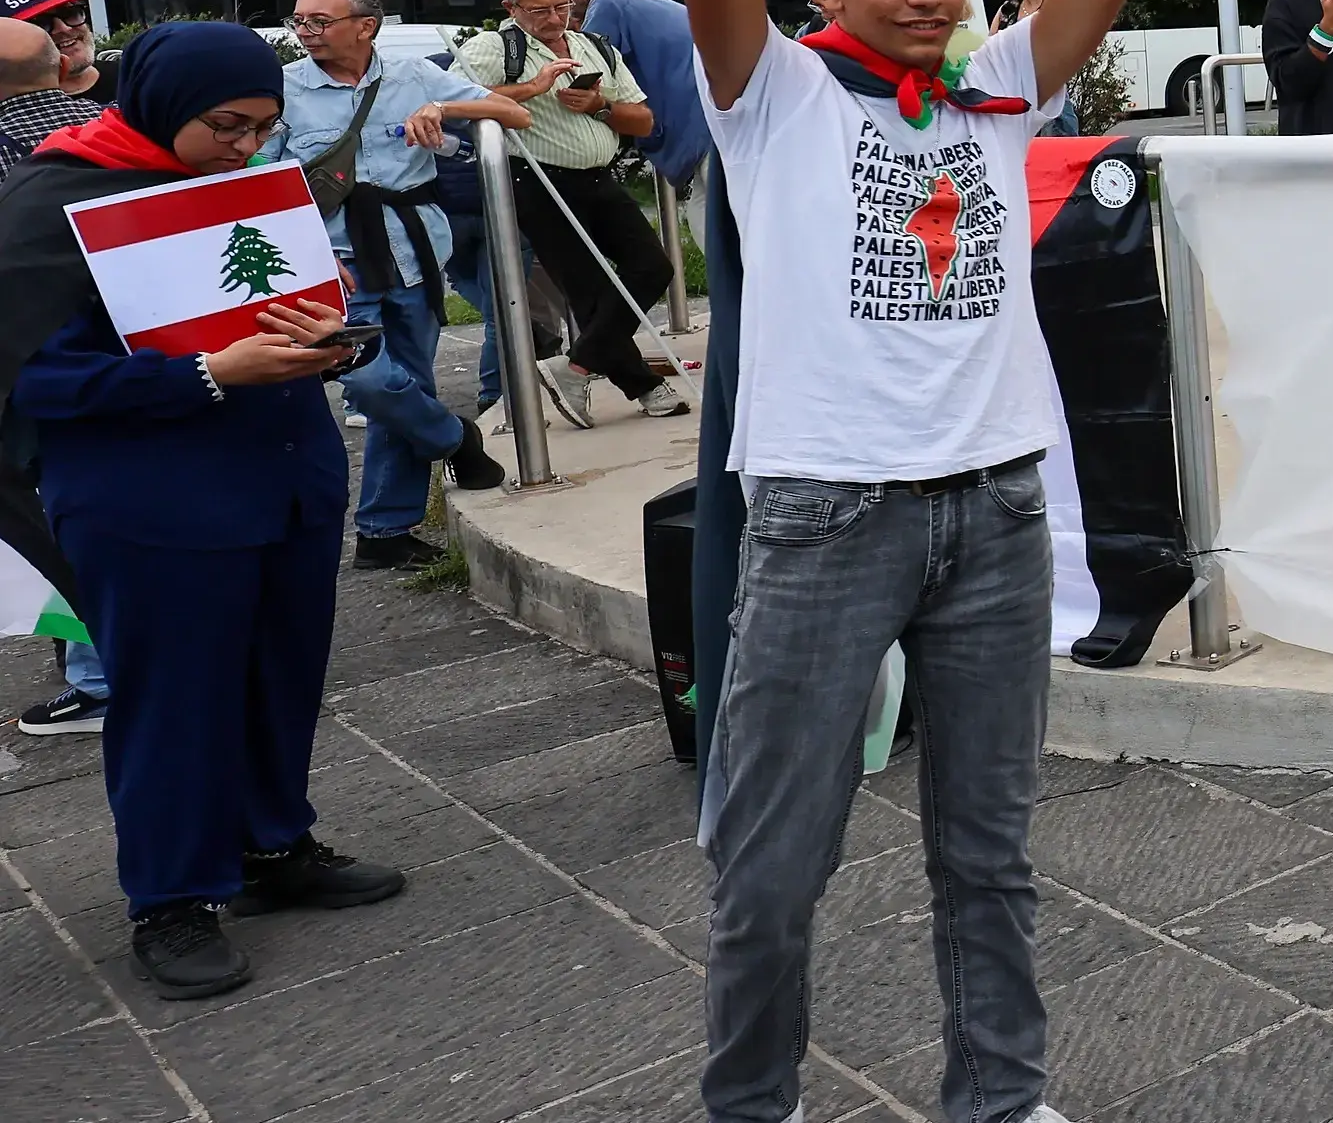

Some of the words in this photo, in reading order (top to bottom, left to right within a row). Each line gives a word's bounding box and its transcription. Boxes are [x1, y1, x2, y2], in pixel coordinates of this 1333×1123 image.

[1104, 161, 1119, 169] FREE
[1119, 164, 1134, 198] PALESTINE
[1102, 197, 1124, 207] ISRAEL
[959, 276, 1005, 299] LIBERA
[850, 300, 953, 322] PALESTINA
